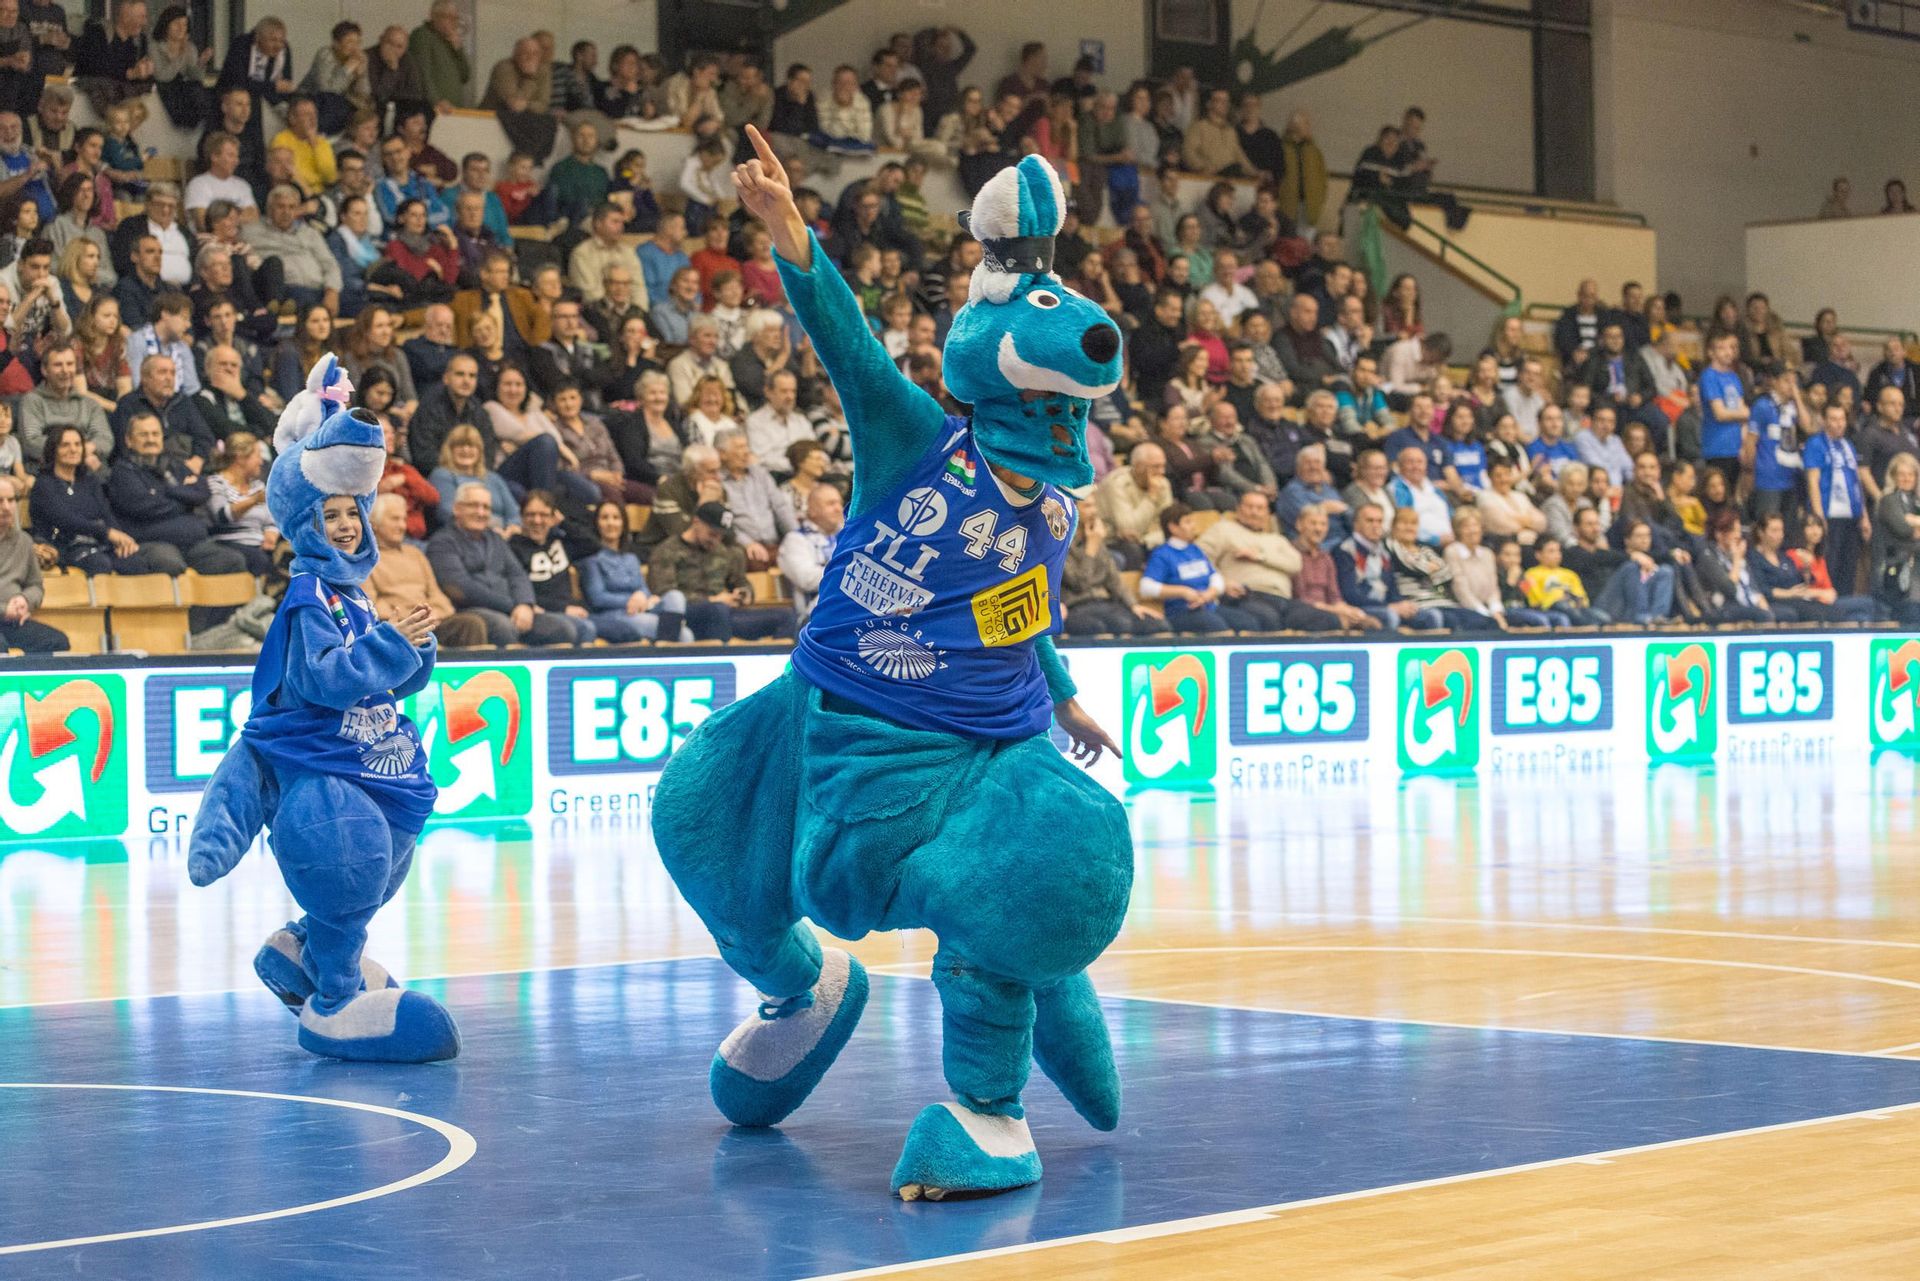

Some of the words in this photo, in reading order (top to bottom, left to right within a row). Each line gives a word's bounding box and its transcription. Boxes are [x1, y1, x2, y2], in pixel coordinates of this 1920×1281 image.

[942, 472, 977, 498] SPALDING
[864, 519, 940, 582] TLI
[959, 508, 1028, 574] 44
[989, 594, 1008, 640] GARZON
[1246, 661, 1357, 735] E85
[1506, 656, 1602, 726] E85
[1739, 651, 1823, 716] E85
[1230, 754, 1370, 779] GreenPower
[550, 785, 655, 814] Green
